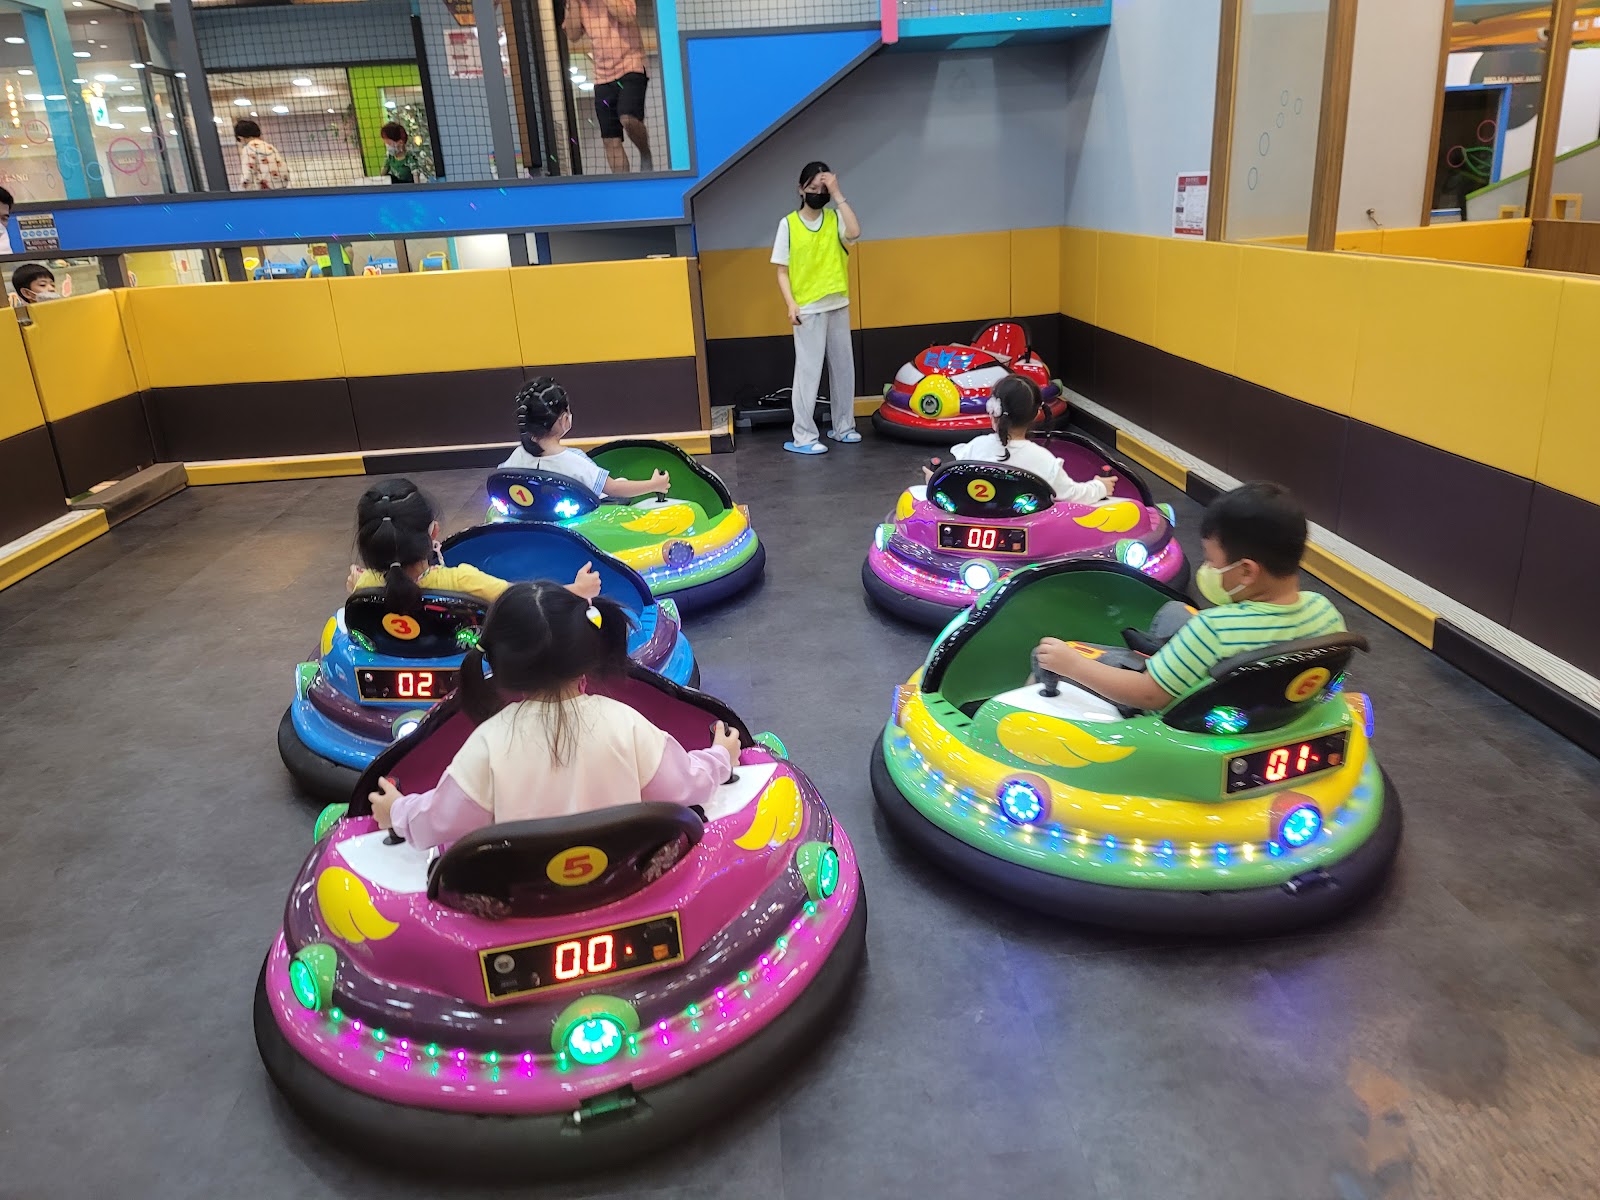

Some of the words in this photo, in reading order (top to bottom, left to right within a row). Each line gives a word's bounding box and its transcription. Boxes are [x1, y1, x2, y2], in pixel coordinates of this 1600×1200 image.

[516, 489, 526, 502] 1
[974, 484, 989, 499] 2
[967, 528, 996, 549] 00
[390, 618, 412, 635] 3
[398, 672, 433, 697] 02
[563, 854, 593, 879] 5
